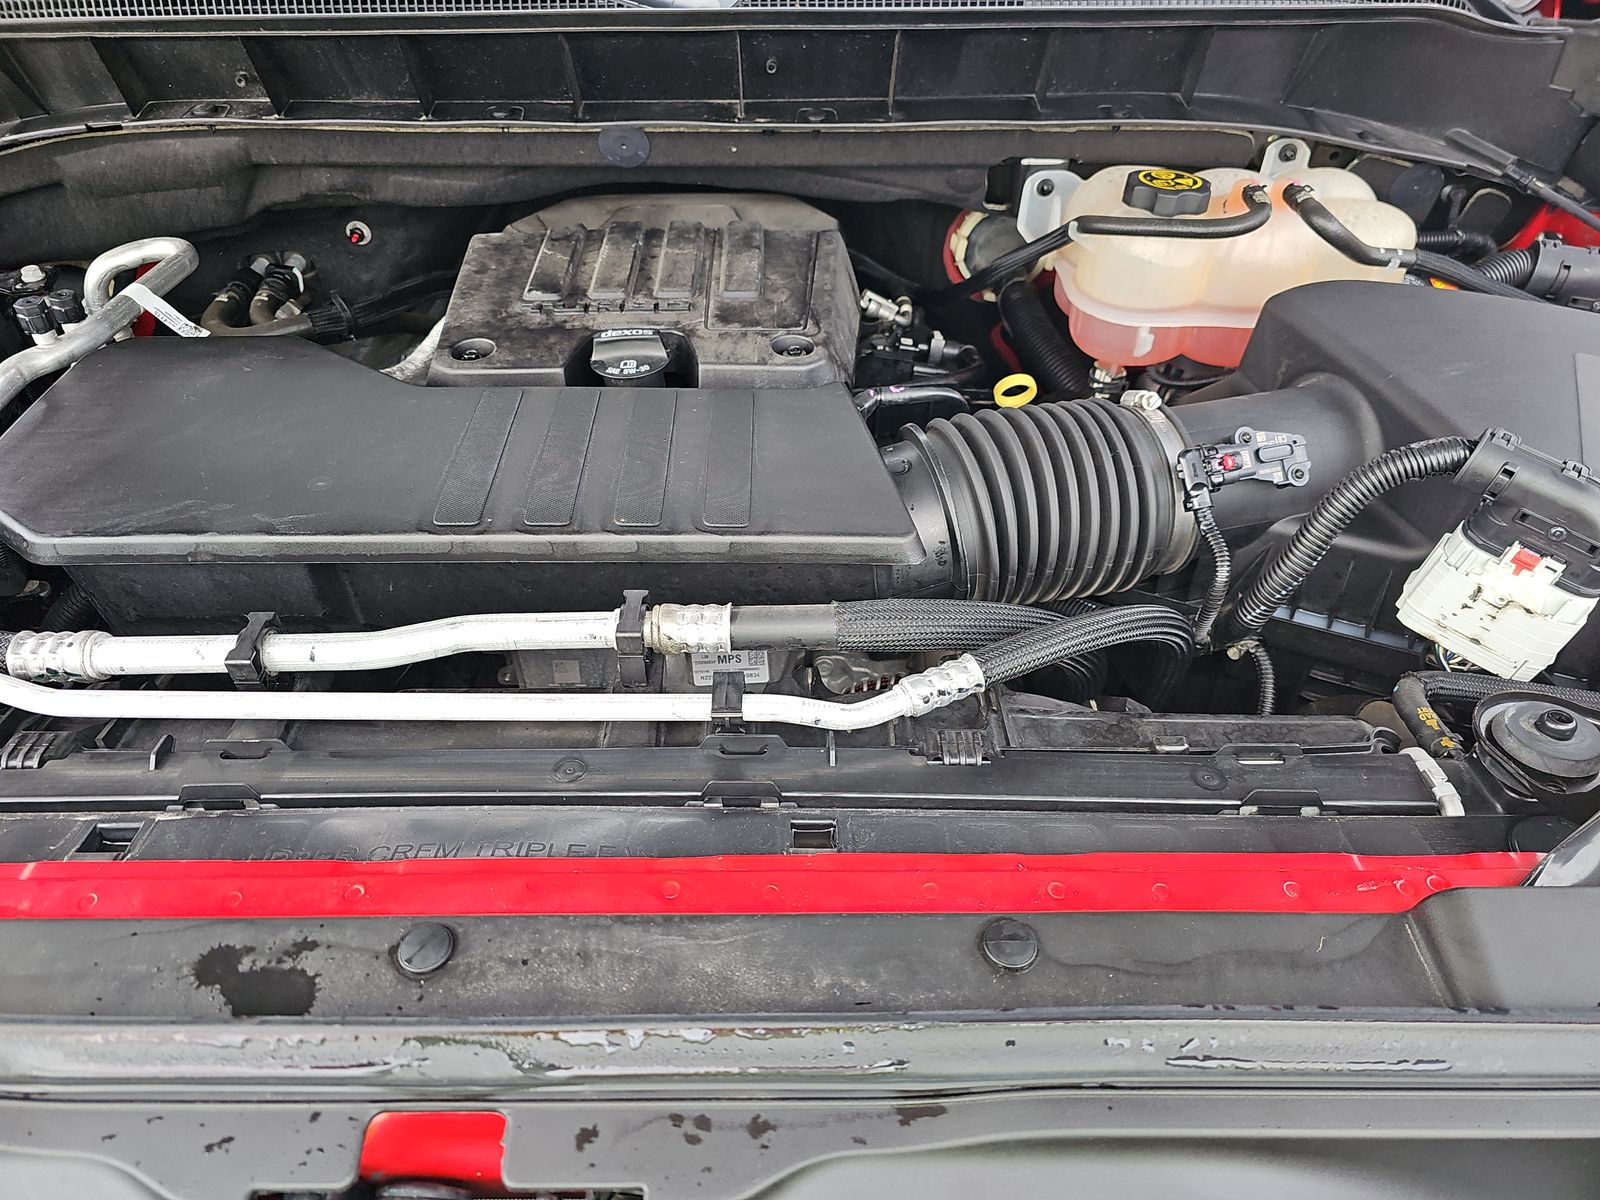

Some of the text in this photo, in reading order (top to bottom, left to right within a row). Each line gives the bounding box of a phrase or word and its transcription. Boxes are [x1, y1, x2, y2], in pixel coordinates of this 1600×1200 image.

[600, 329, 655, 338] dexos
[605, 364, 651, 375] SAE 5W-30
[717, 653, 742, 664] MPS
